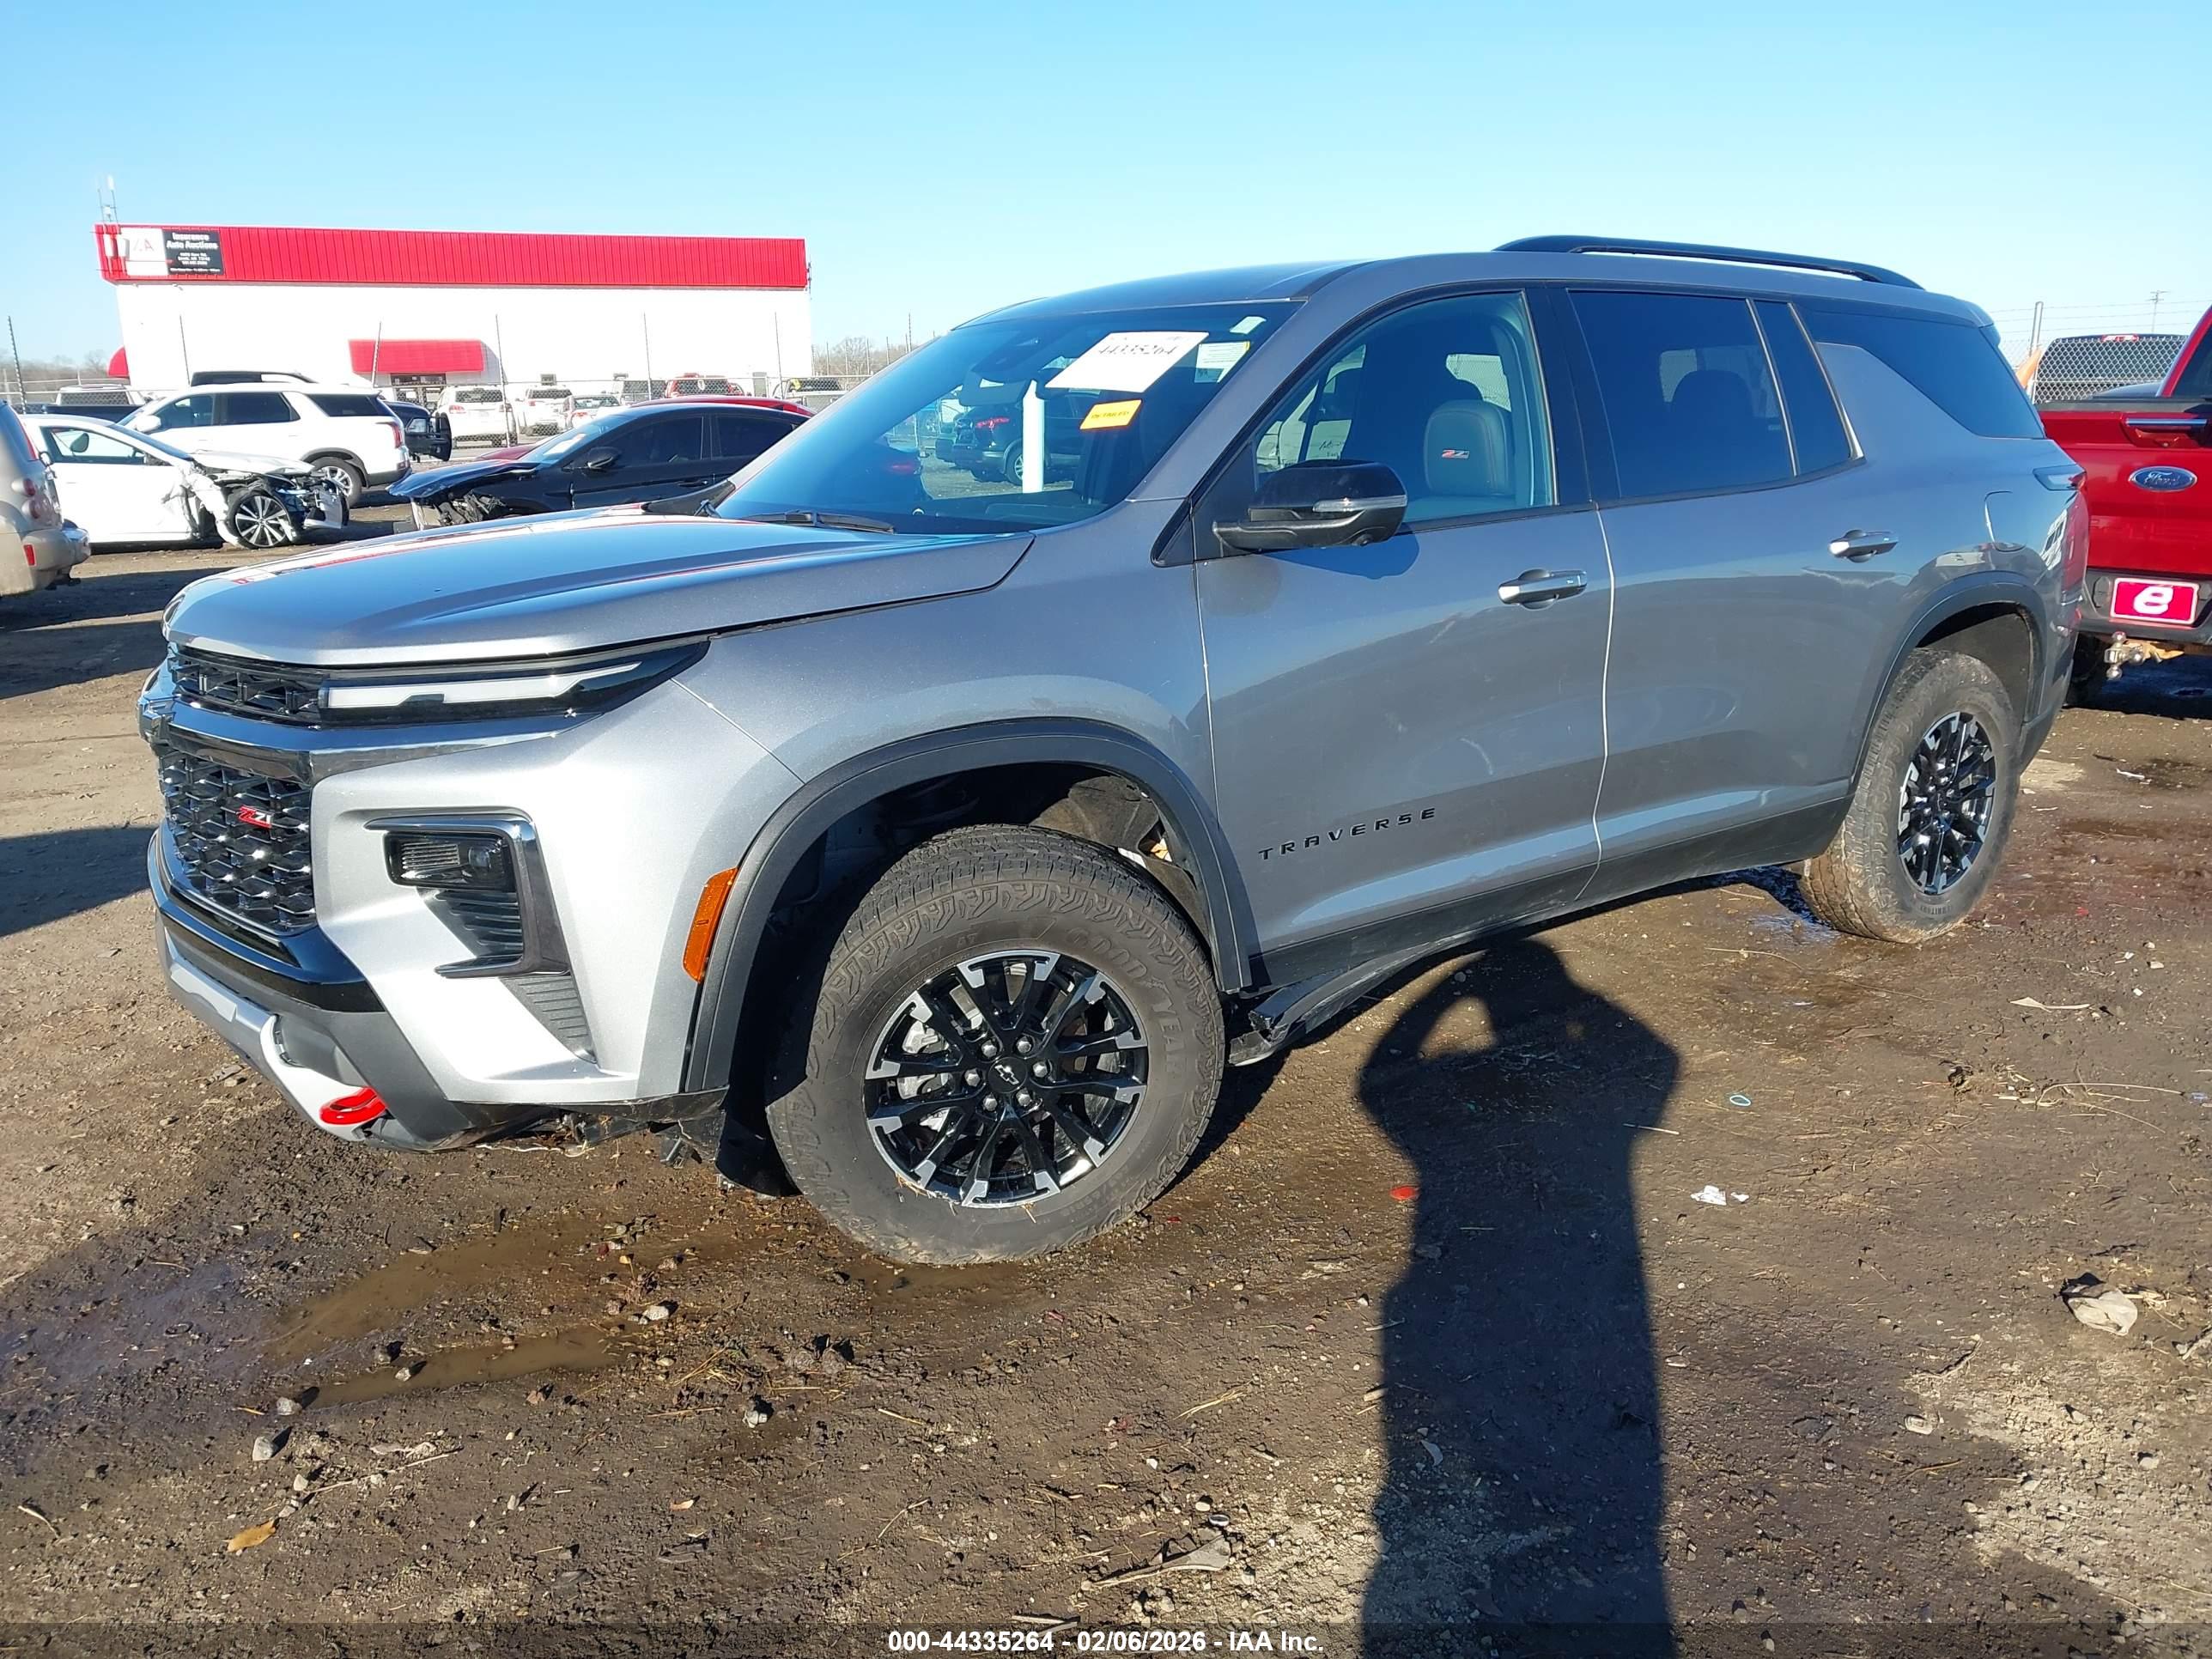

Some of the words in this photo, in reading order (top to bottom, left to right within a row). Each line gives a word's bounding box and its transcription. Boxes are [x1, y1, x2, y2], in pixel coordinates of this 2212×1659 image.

[167, 240, 184, 249] Auto
[185, 240, 218, 249] Auctions
[2144, 471, 2181, 486] Ford
[1258, 807, 1436, 860] TRAVERSE
